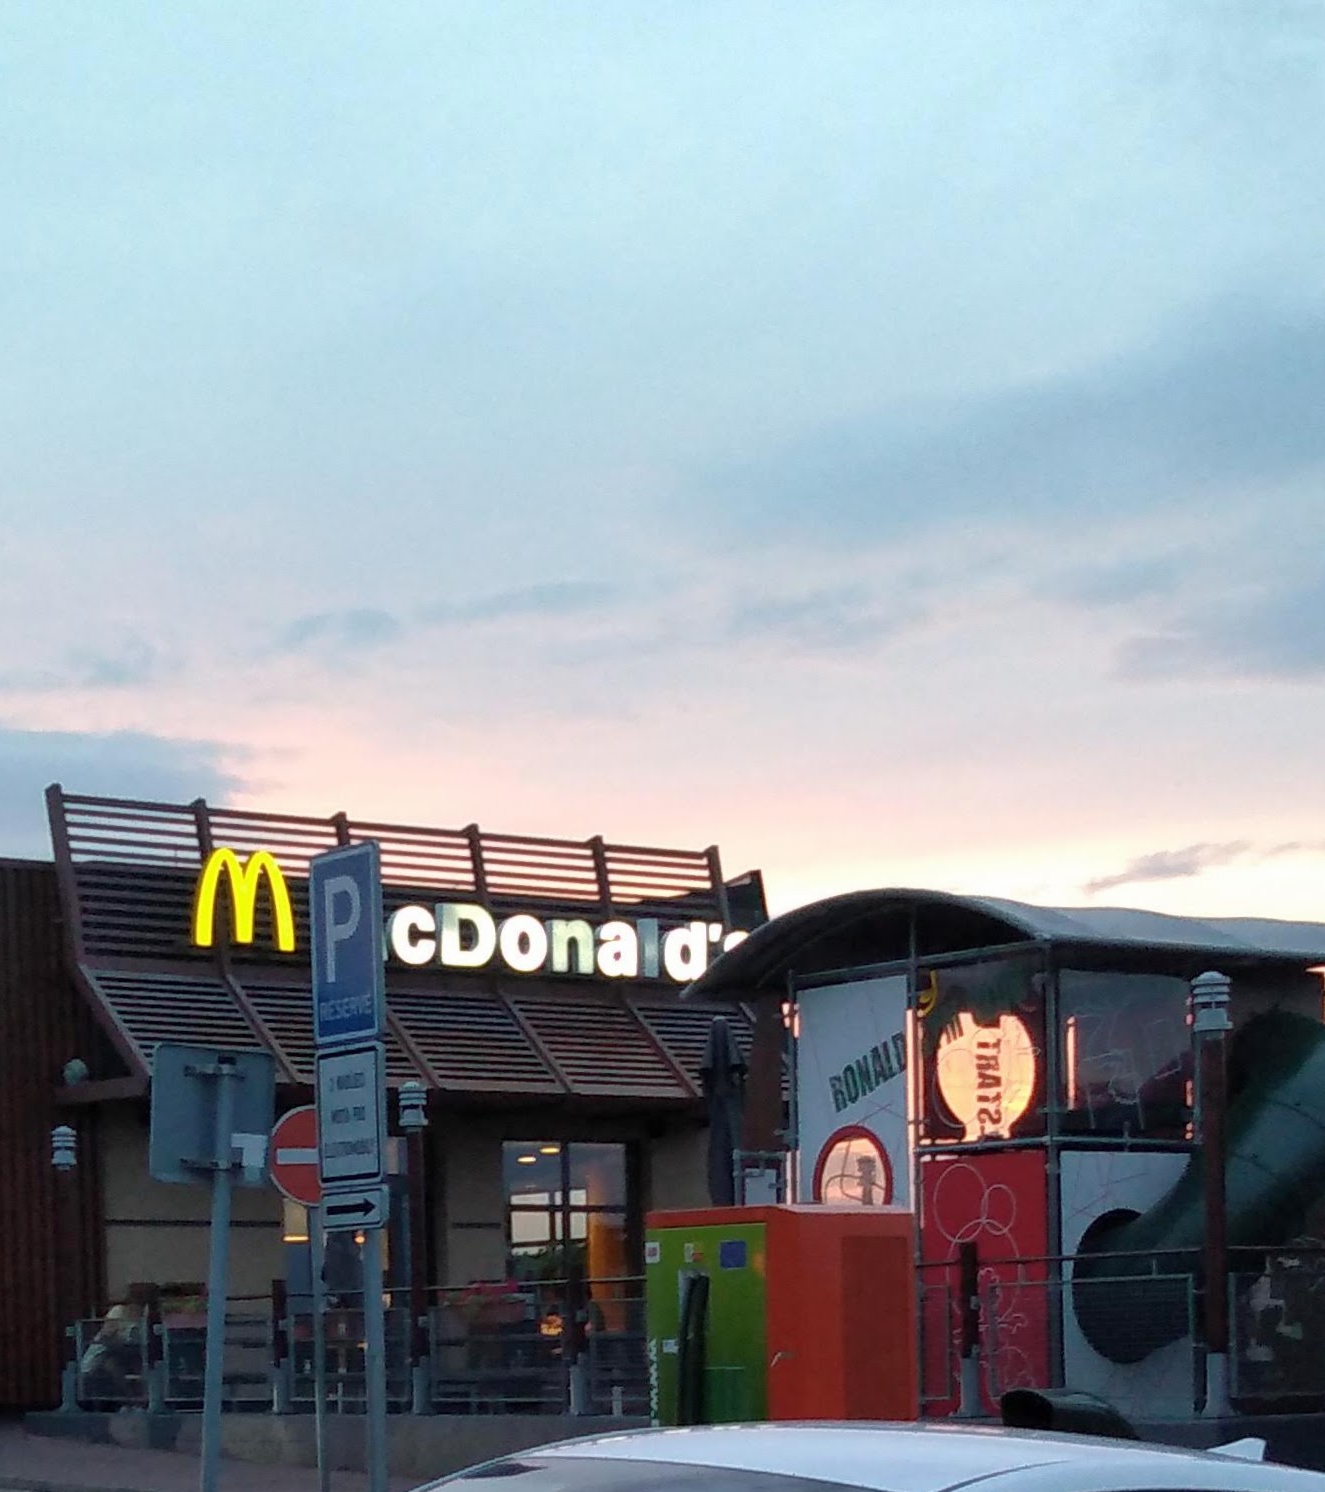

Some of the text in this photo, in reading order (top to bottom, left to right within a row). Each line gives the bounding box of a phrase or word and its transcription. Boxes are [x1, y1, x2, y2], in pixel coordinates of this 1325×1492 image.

[325, 875, 361, 983] P
[382, 902, 751, 982] cDonald'
[829, 1031, 908, 1113] RONALD
